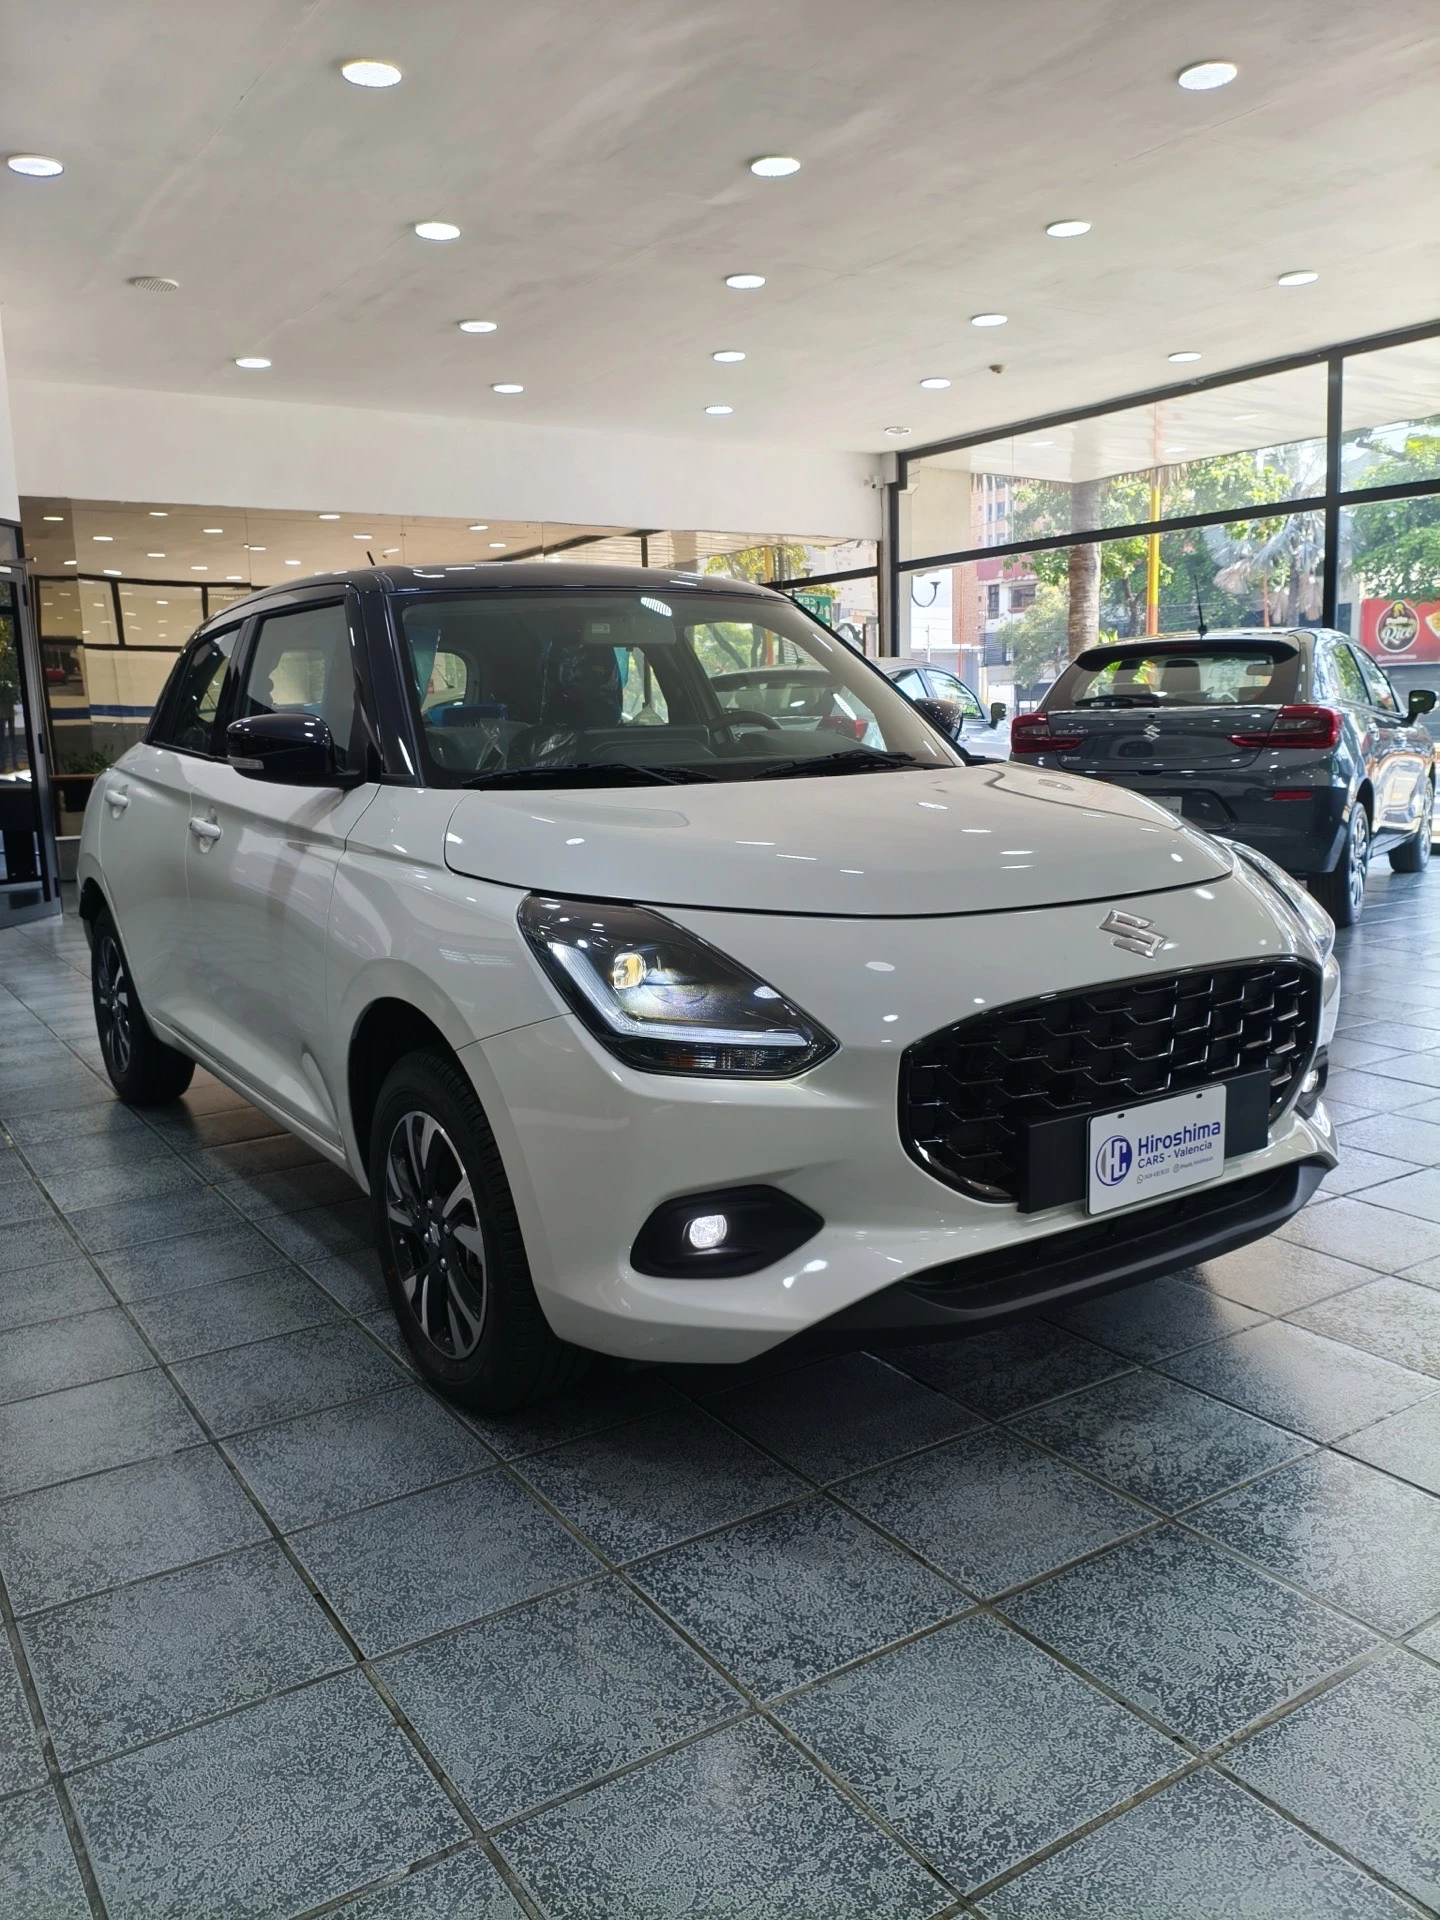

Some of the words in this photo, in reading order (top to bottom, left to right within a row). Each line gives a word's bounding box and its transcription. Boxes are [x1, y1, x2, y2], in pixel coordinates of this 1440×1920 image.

[1380, 627, 1413, 645] Rico
[1138, 1121, 1221, 1157] Hiroshima
[1138, 1153, 1165, 1169] CARS
[1173, 1140, 1213, 1159] Valencia
